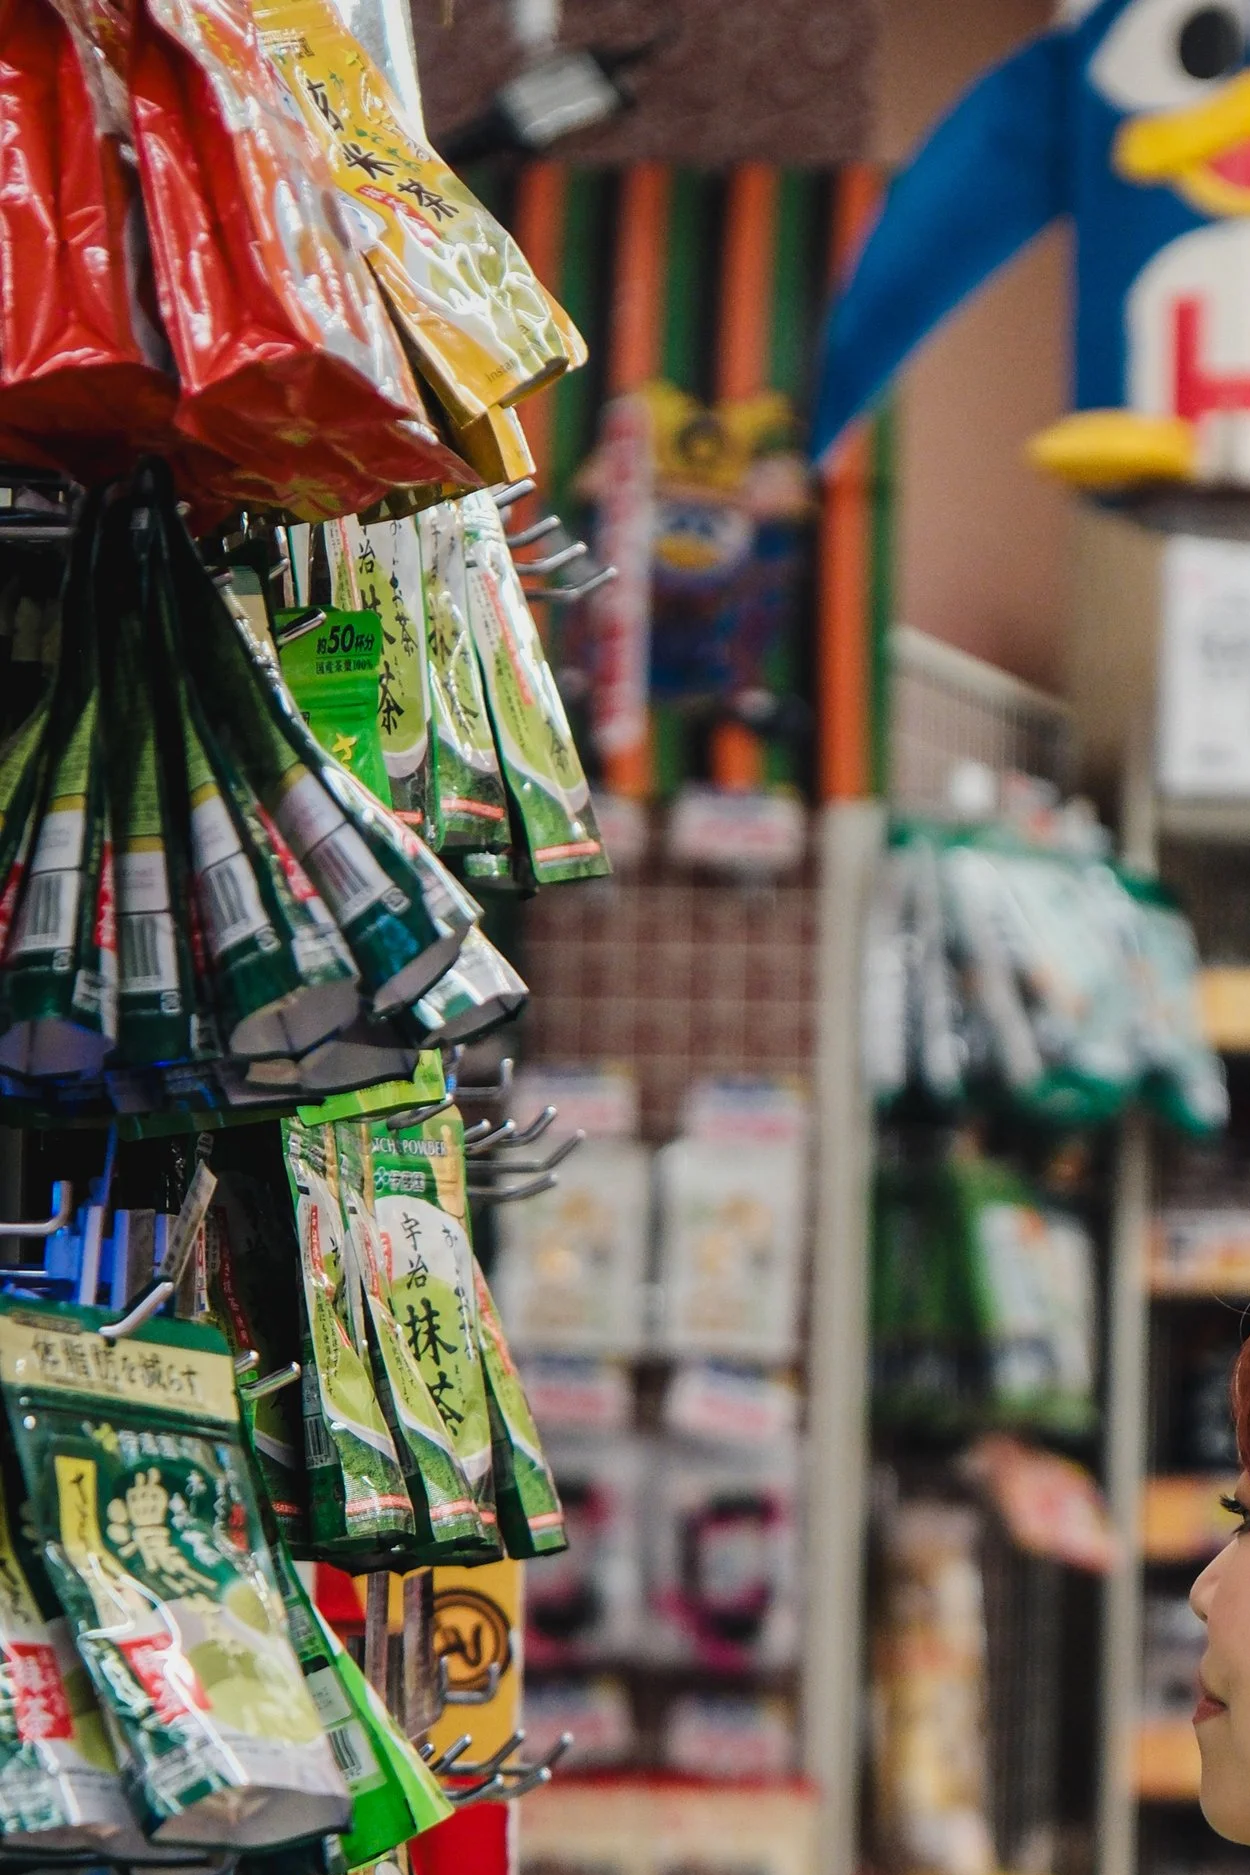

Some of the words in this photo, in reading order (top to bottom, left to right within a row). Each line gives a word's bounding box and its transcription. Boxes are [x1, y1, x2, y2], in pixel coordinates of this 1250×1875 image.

[306, 78, 460, 222] 玄米茶
[316, 623, 376, 655] 約50杯分
[315, 658, 374, 675] 国産茶葉100%
[402, 1138, 447, 1158] POWDER
[400, 1211, 465, 1438] 宇治抹茶
